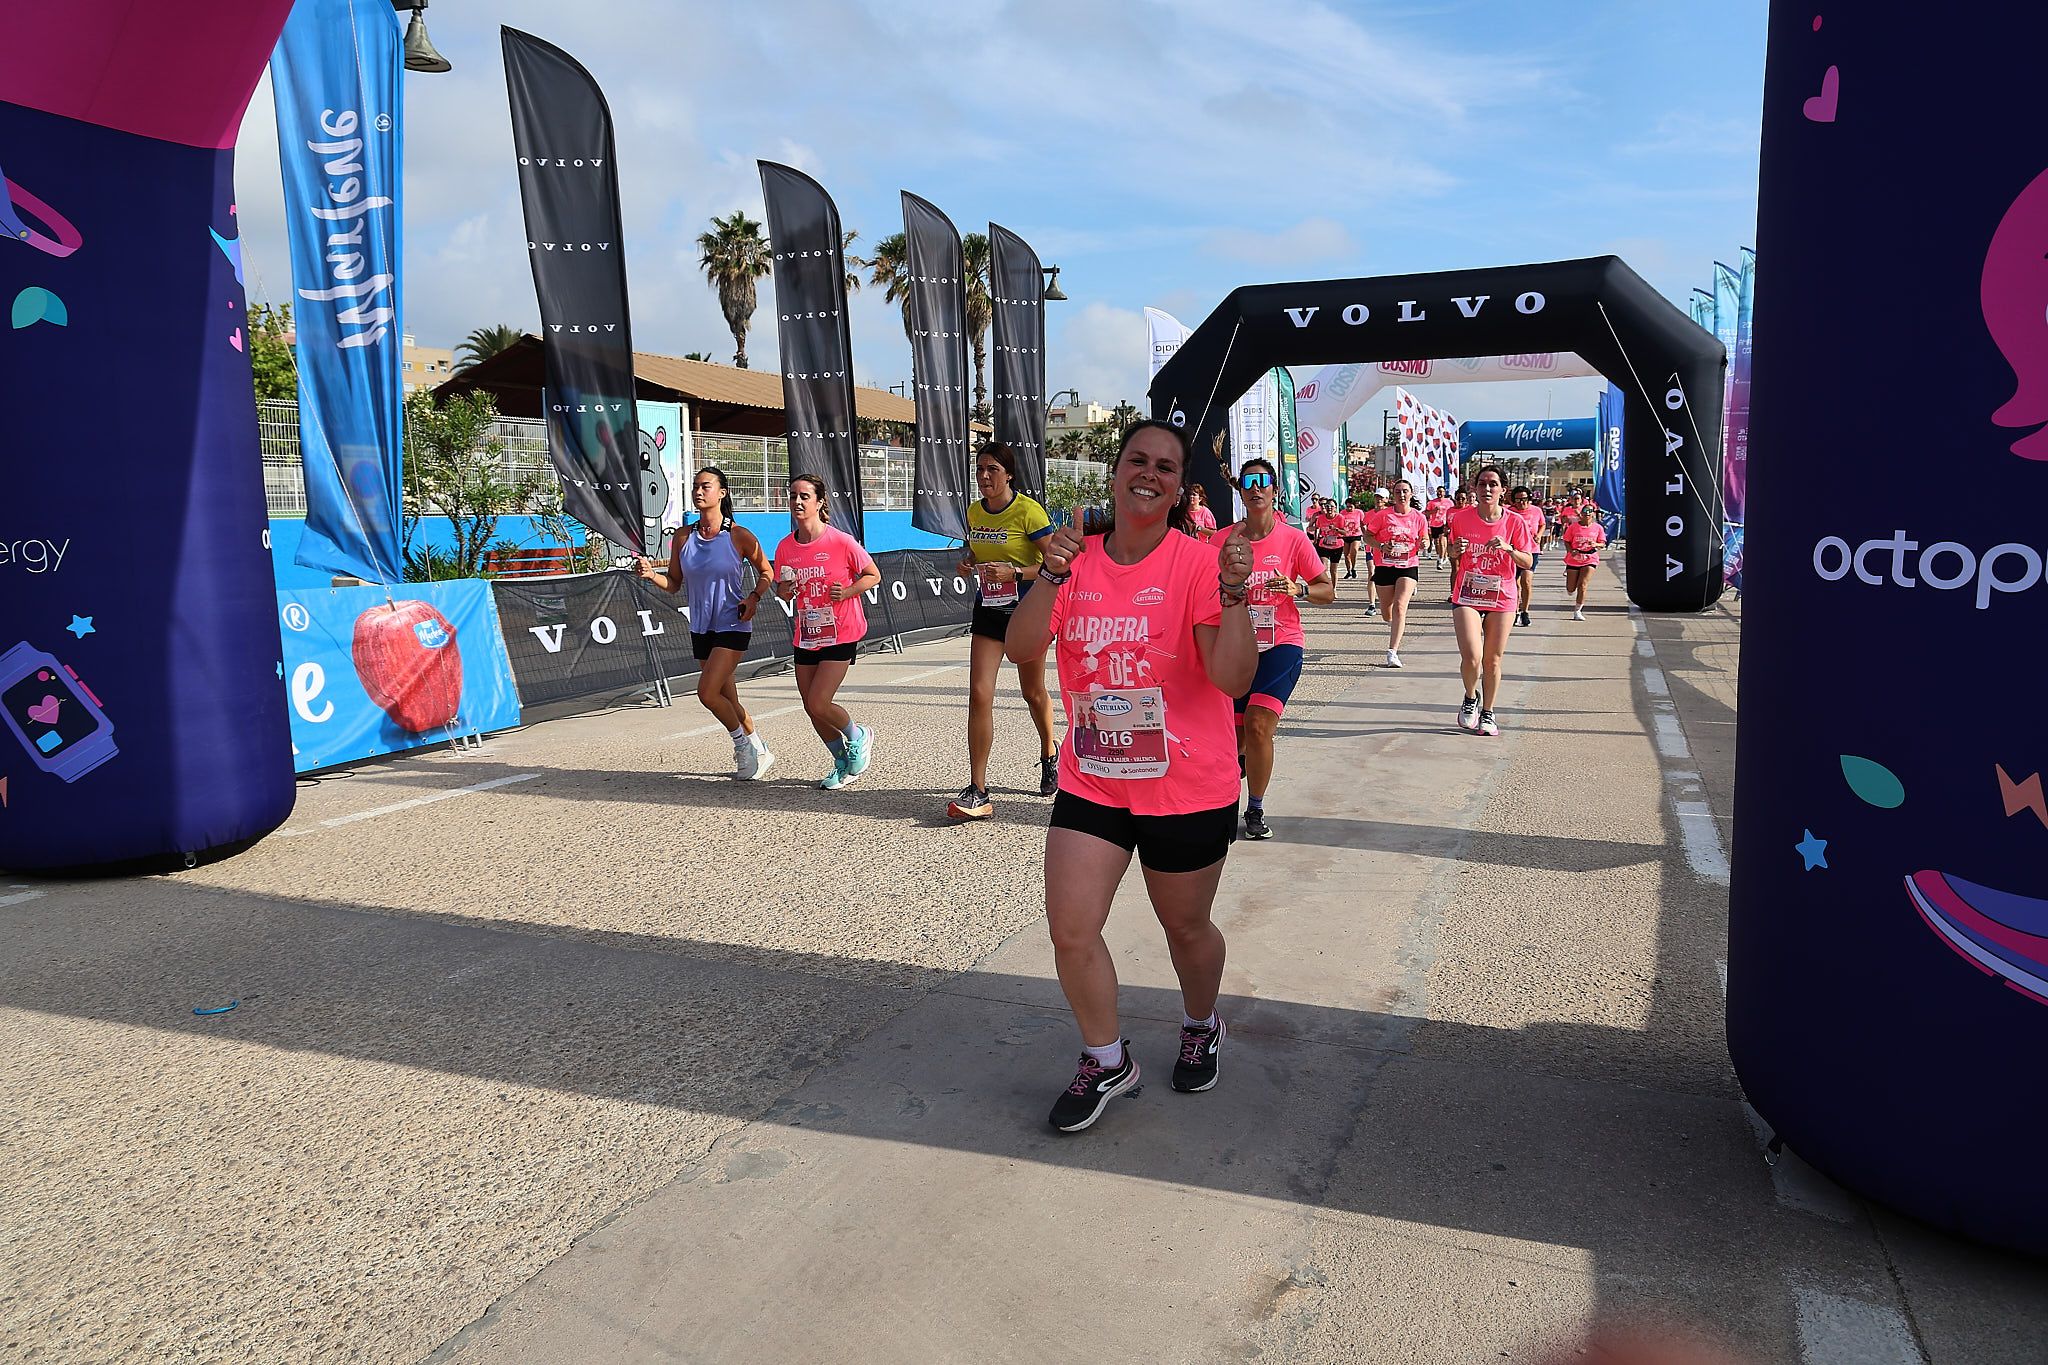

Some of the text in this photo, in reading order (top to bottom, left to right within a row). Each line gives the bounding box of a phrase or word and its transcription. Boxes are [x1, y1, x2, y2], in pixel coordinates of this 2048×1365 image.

[1283, 291, 1545, 328] VOLVO
[1381, 359, 1428, 375] COSMO
[1503, 353, 1553, 369] COSMO
[1505, 422, 1563, 447] Marlene
[1665, 388, 1684, 582] VOLVO
[1813, 529, 2048, 610] octop
[987, 582, 1003, 591] 016
[1471, 588, 1487, 596] 016
[1069, 591, 1103, 602] OSHO
[807, 626, 822, 635] 016
[1108, 651, 1135, 687] DE
[1095, 702, 1130, 711] ASTURIANA
[1099, 730, 1134, 747] 016
[1128, 767, 1159, 775] Santander
